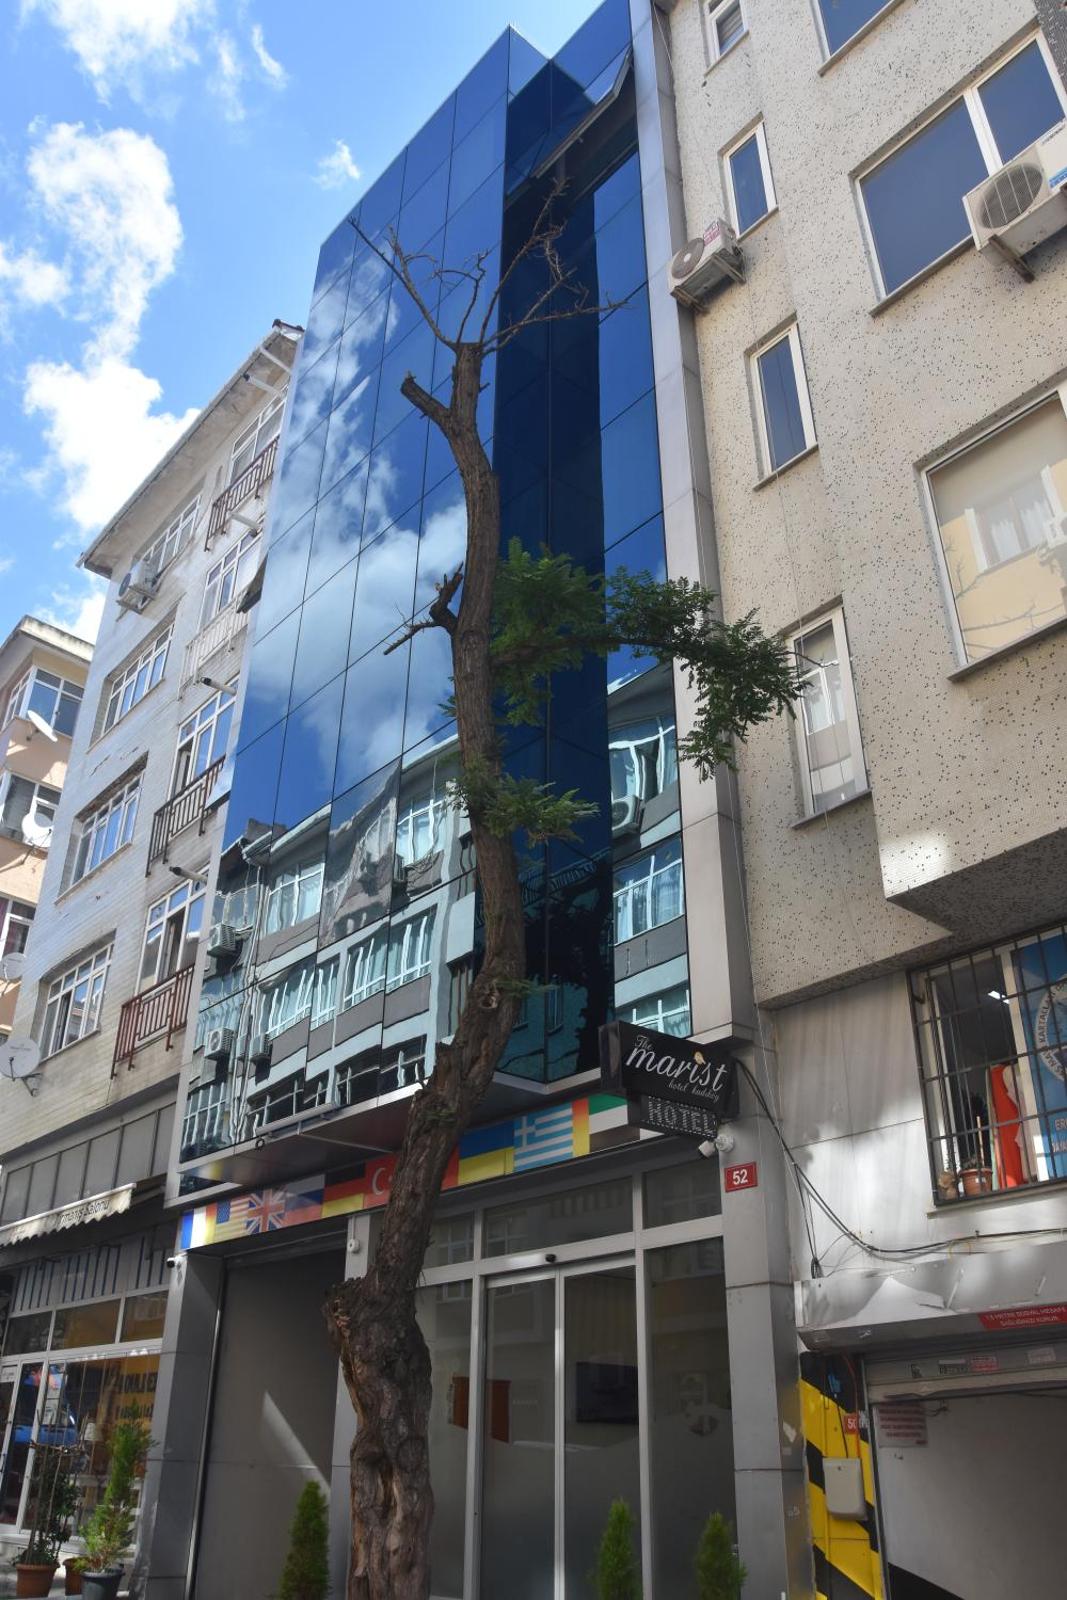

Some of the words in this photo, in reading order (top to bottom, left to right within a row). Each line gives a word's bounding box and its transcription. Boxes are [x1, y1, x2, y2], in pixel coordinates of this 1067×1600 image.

[634, 1034, 653, 1051] The
[669, 1079, 689, 1093] hotel
[648, 1100, 715, 1135] HOTEL
[732, 1168, 748, 1185] 52
